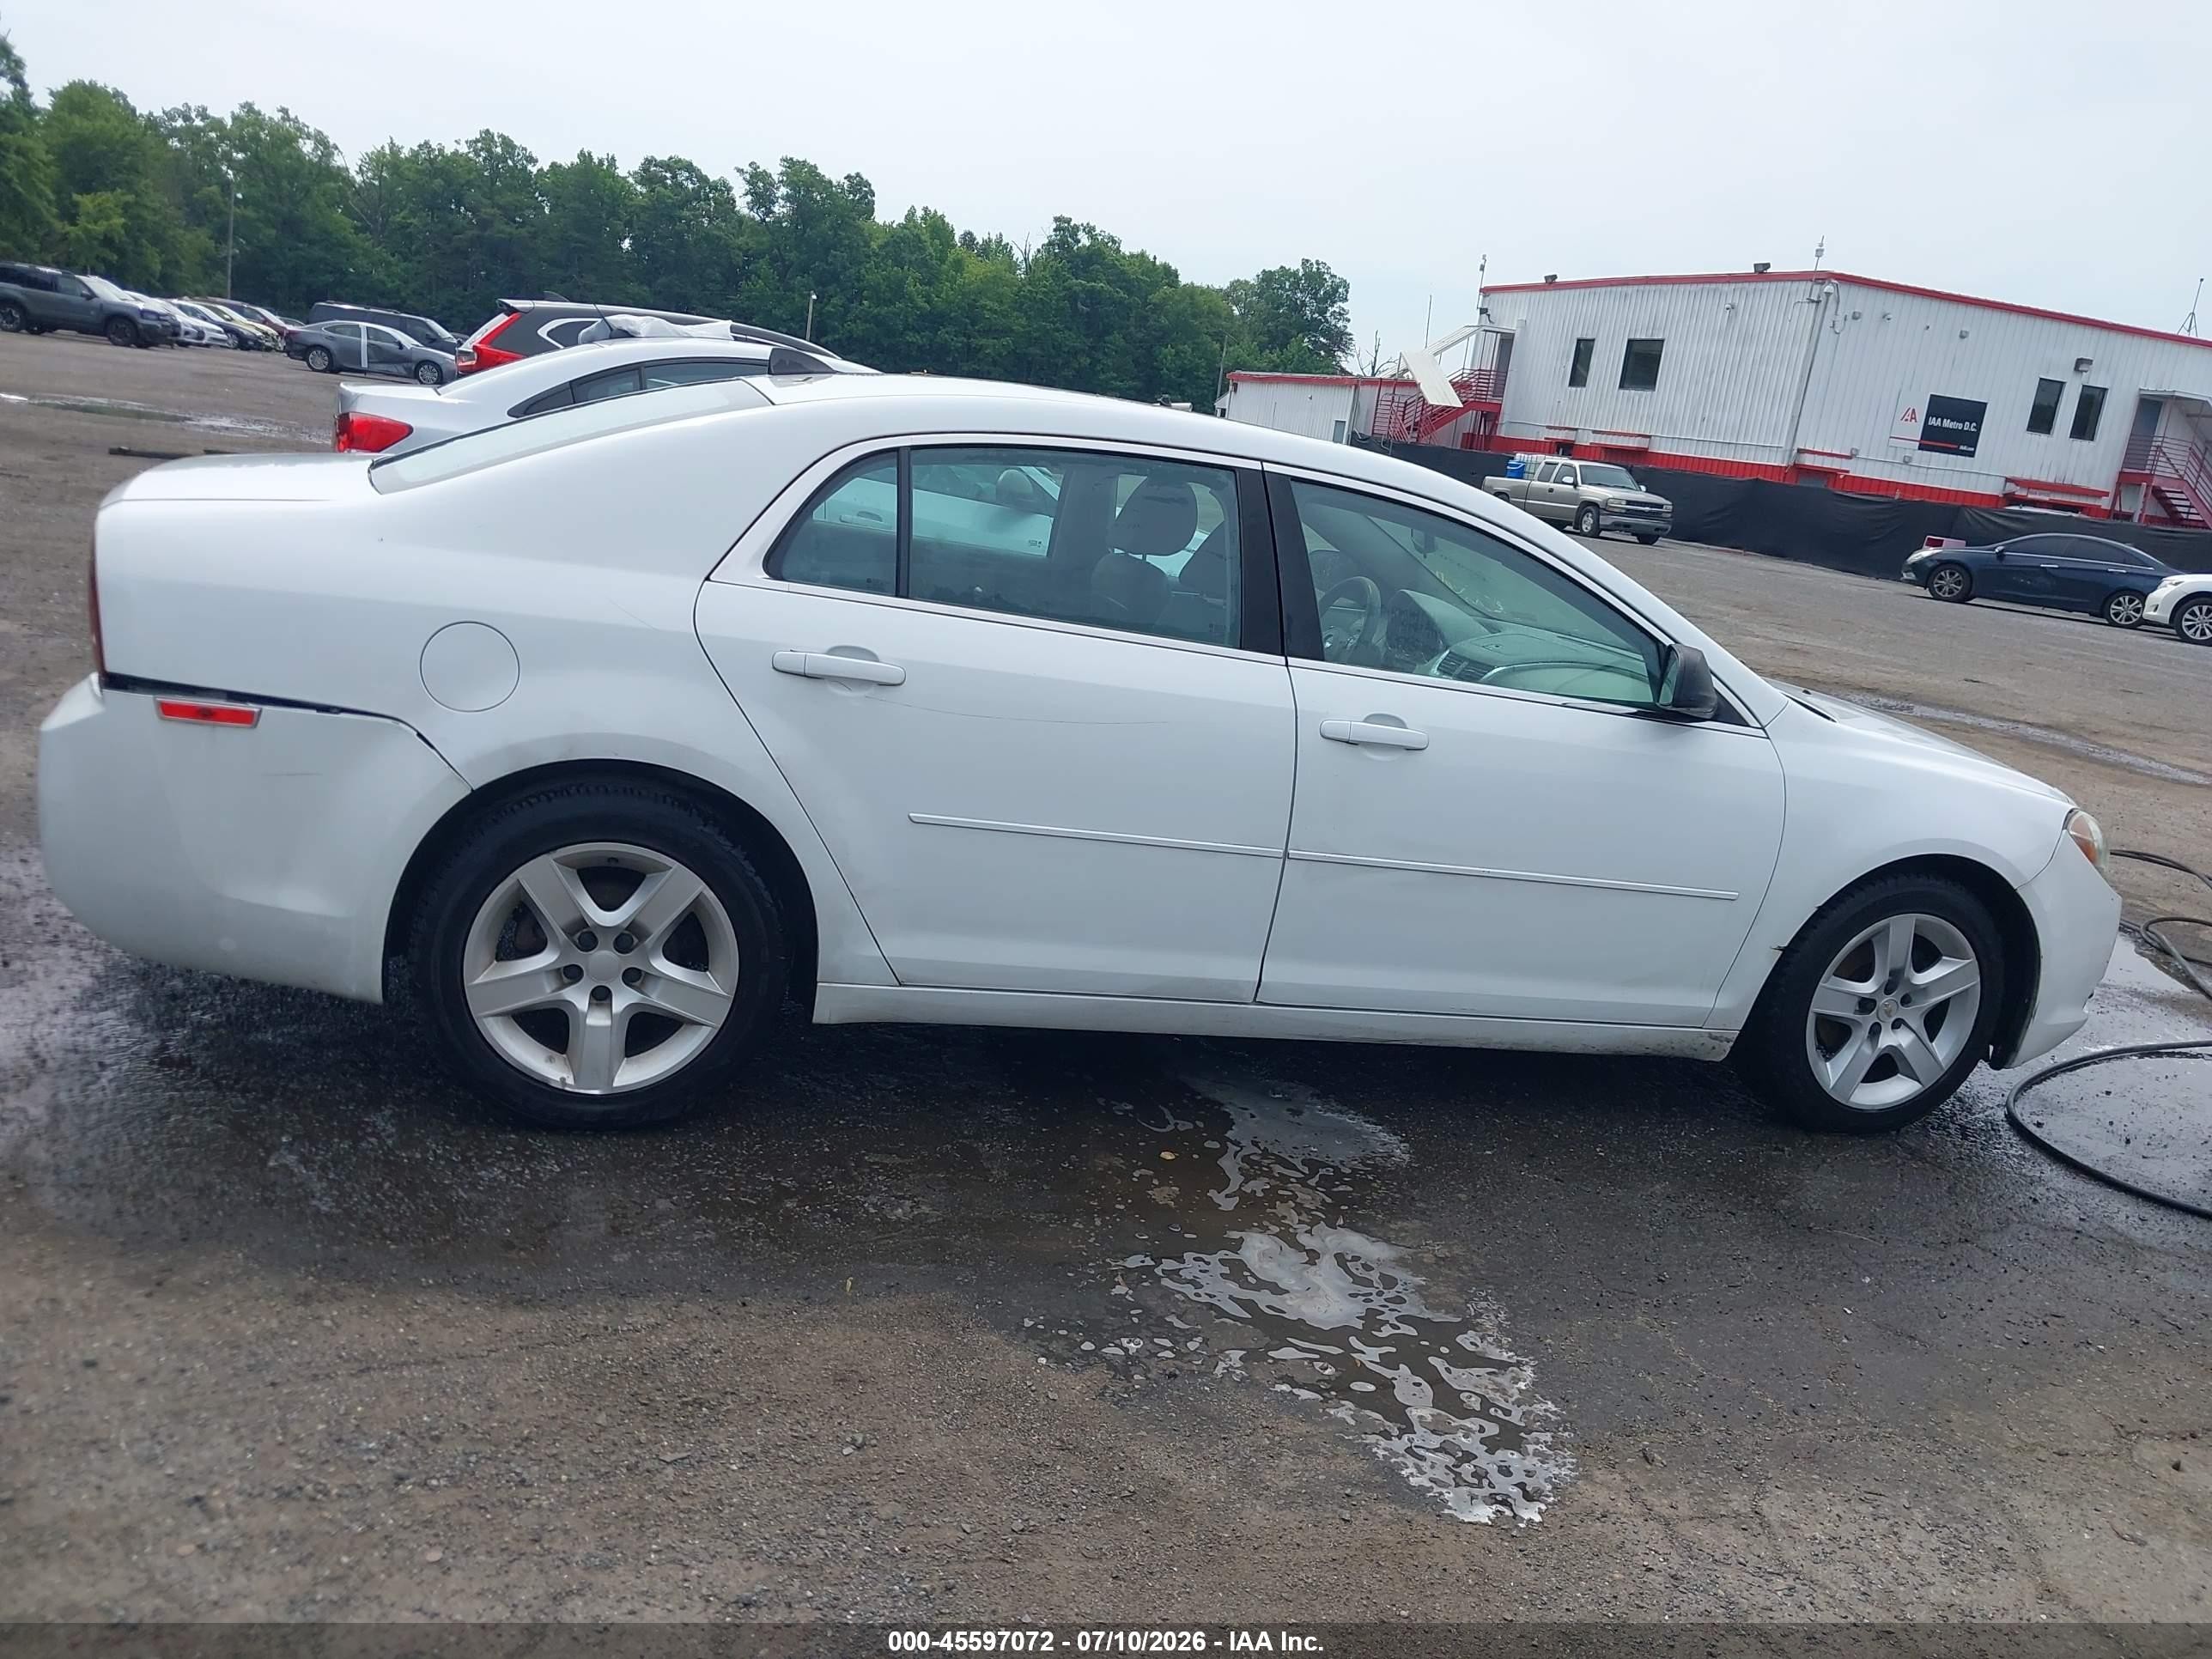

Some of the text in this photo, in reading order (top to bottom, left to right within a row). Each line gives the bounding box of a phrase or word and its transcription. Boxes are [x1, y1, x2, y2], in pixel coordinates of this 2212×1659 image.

[1928, 416, 1977, 432] IAA Metro D.C.
